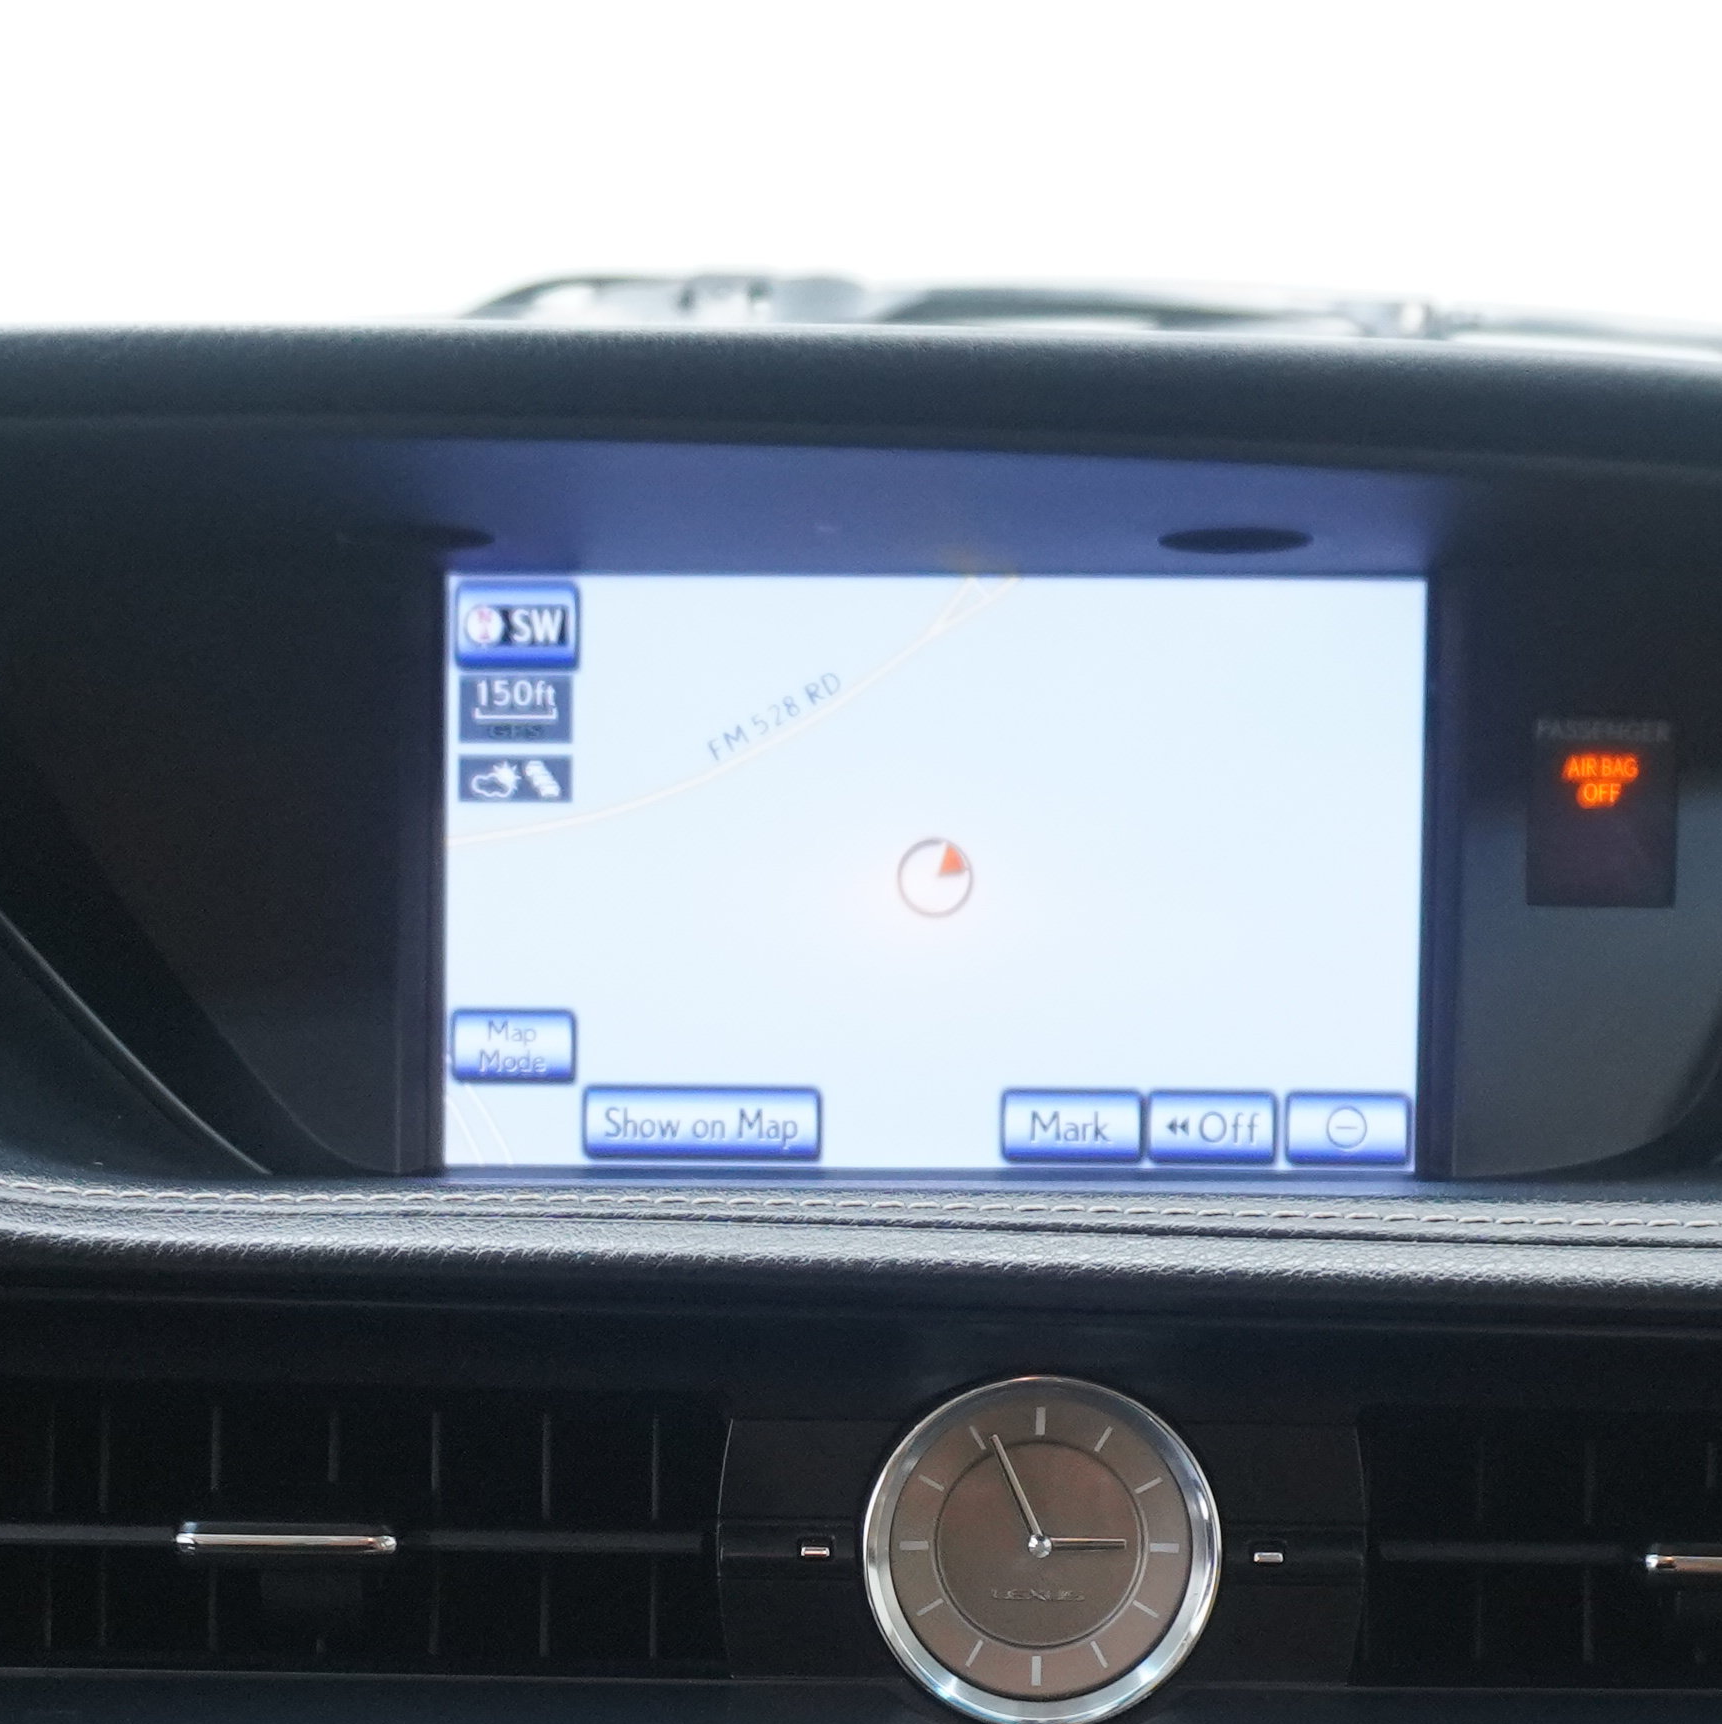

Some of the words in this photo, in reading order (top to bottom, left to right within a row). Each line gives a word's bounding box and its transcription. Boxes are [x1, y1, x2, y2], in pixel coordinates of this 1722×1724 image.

[509, 607, 564, 643] SW
[477, 678, 556, 707] 150ft
[707, 724, 750, 761] FM
[750, 694, 802, 736] 528
[803, 672, 842, 706] RD
[1564, 755, 1597, 779] AIR
[1601, 754, 1639, 779] BAG
[1580, 783, 1622, 806] OFF
[487, 1019, 537, 1044] Map
[479, 1049, 546, 1073] Mode
[604, 1107, 680, 1140] Show
[692, 1118, 726, 1140] on
[737, 1109, 798, 1149] Map
[1030, 1110, 1111, 1145] Mark
[1199, 1111, 1260, 1145] Off
